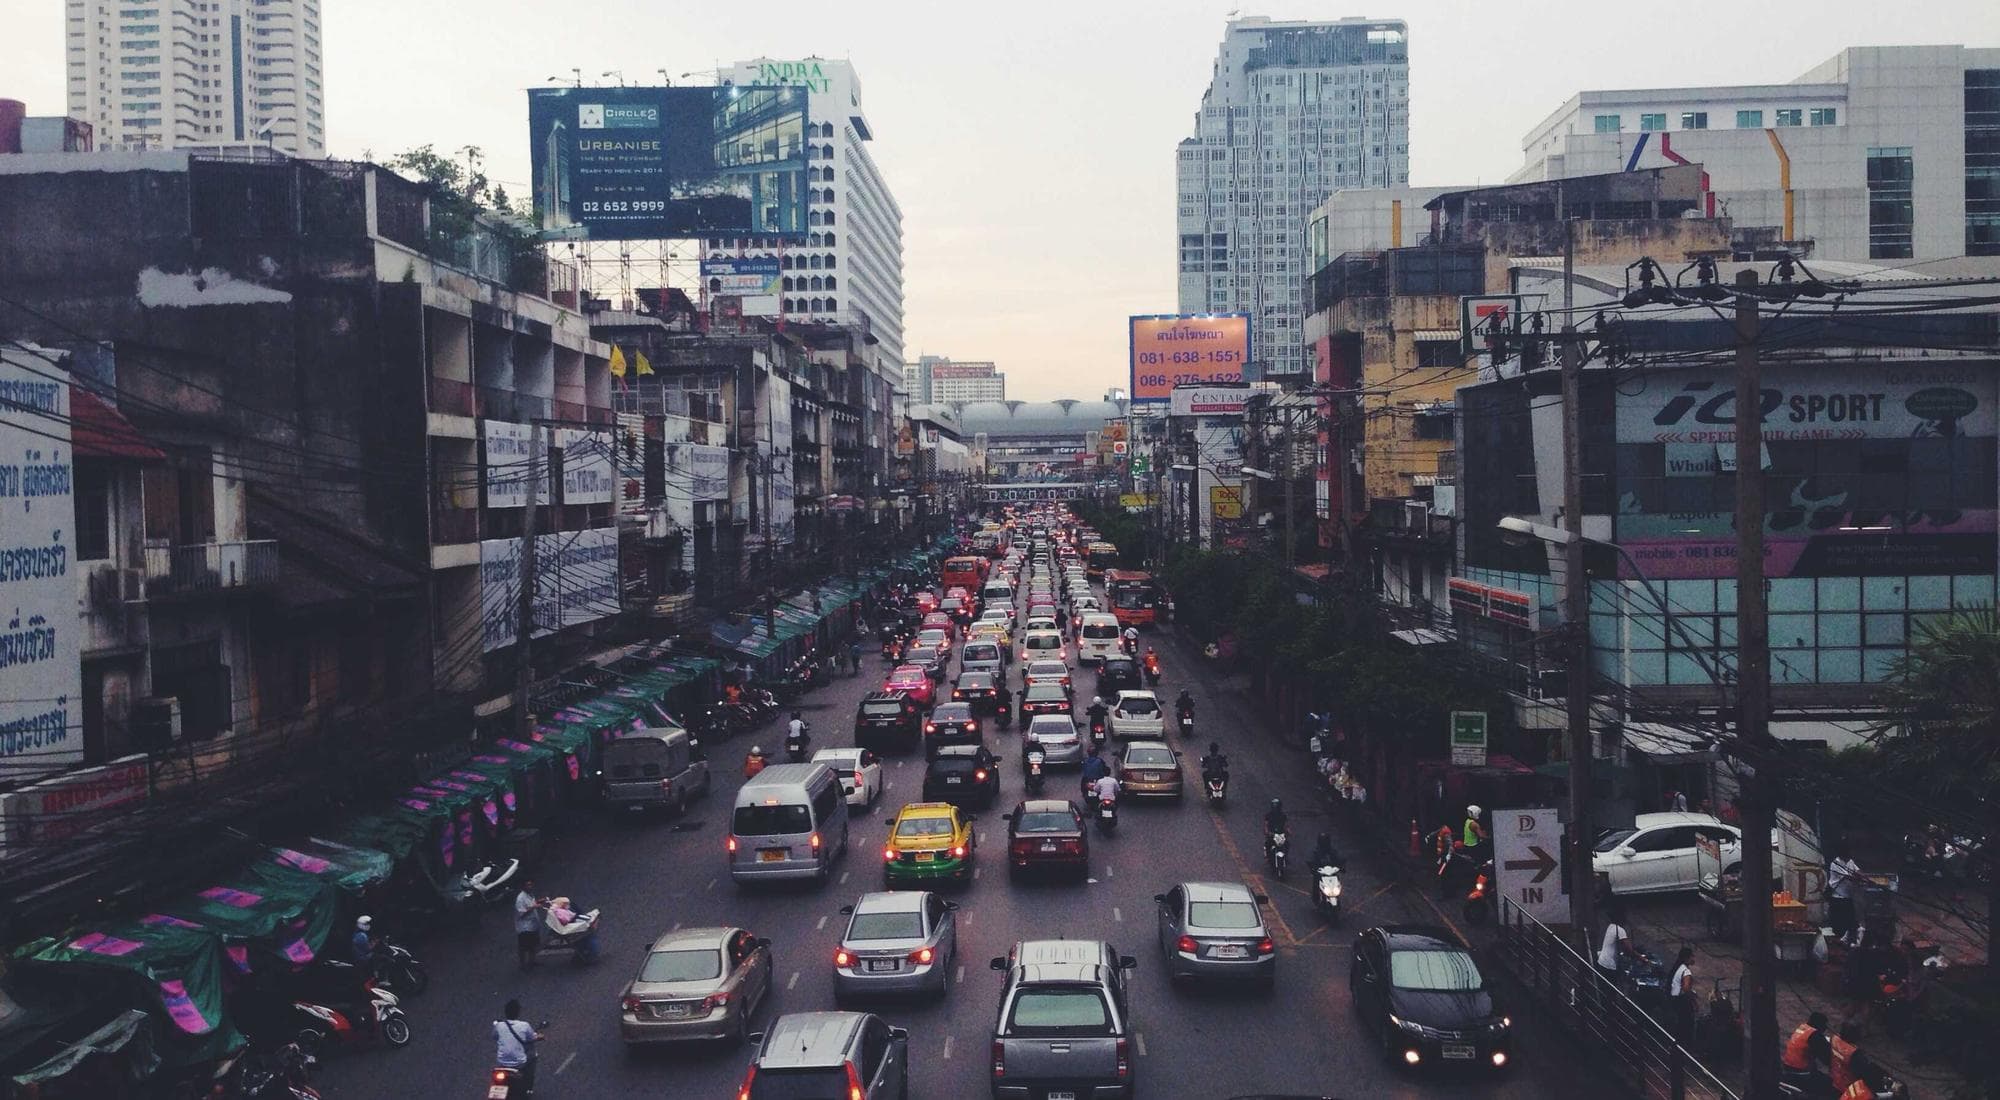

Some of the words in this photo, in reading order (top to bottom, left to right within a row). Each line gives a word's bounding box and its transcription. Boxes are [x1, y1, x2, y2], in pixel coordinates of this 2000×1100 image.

[579, 140, 661, 151] URBANISE
[582, 201, 599, 212] 02
[603, 201, 628, 212] 652
[632, 201, 665, 212] 9999
[1139, 351, 1242, 365] 081-638-1551
[1788, 393, 1885, 423] SPORT
[1522, 888, 1544, 904] IN
